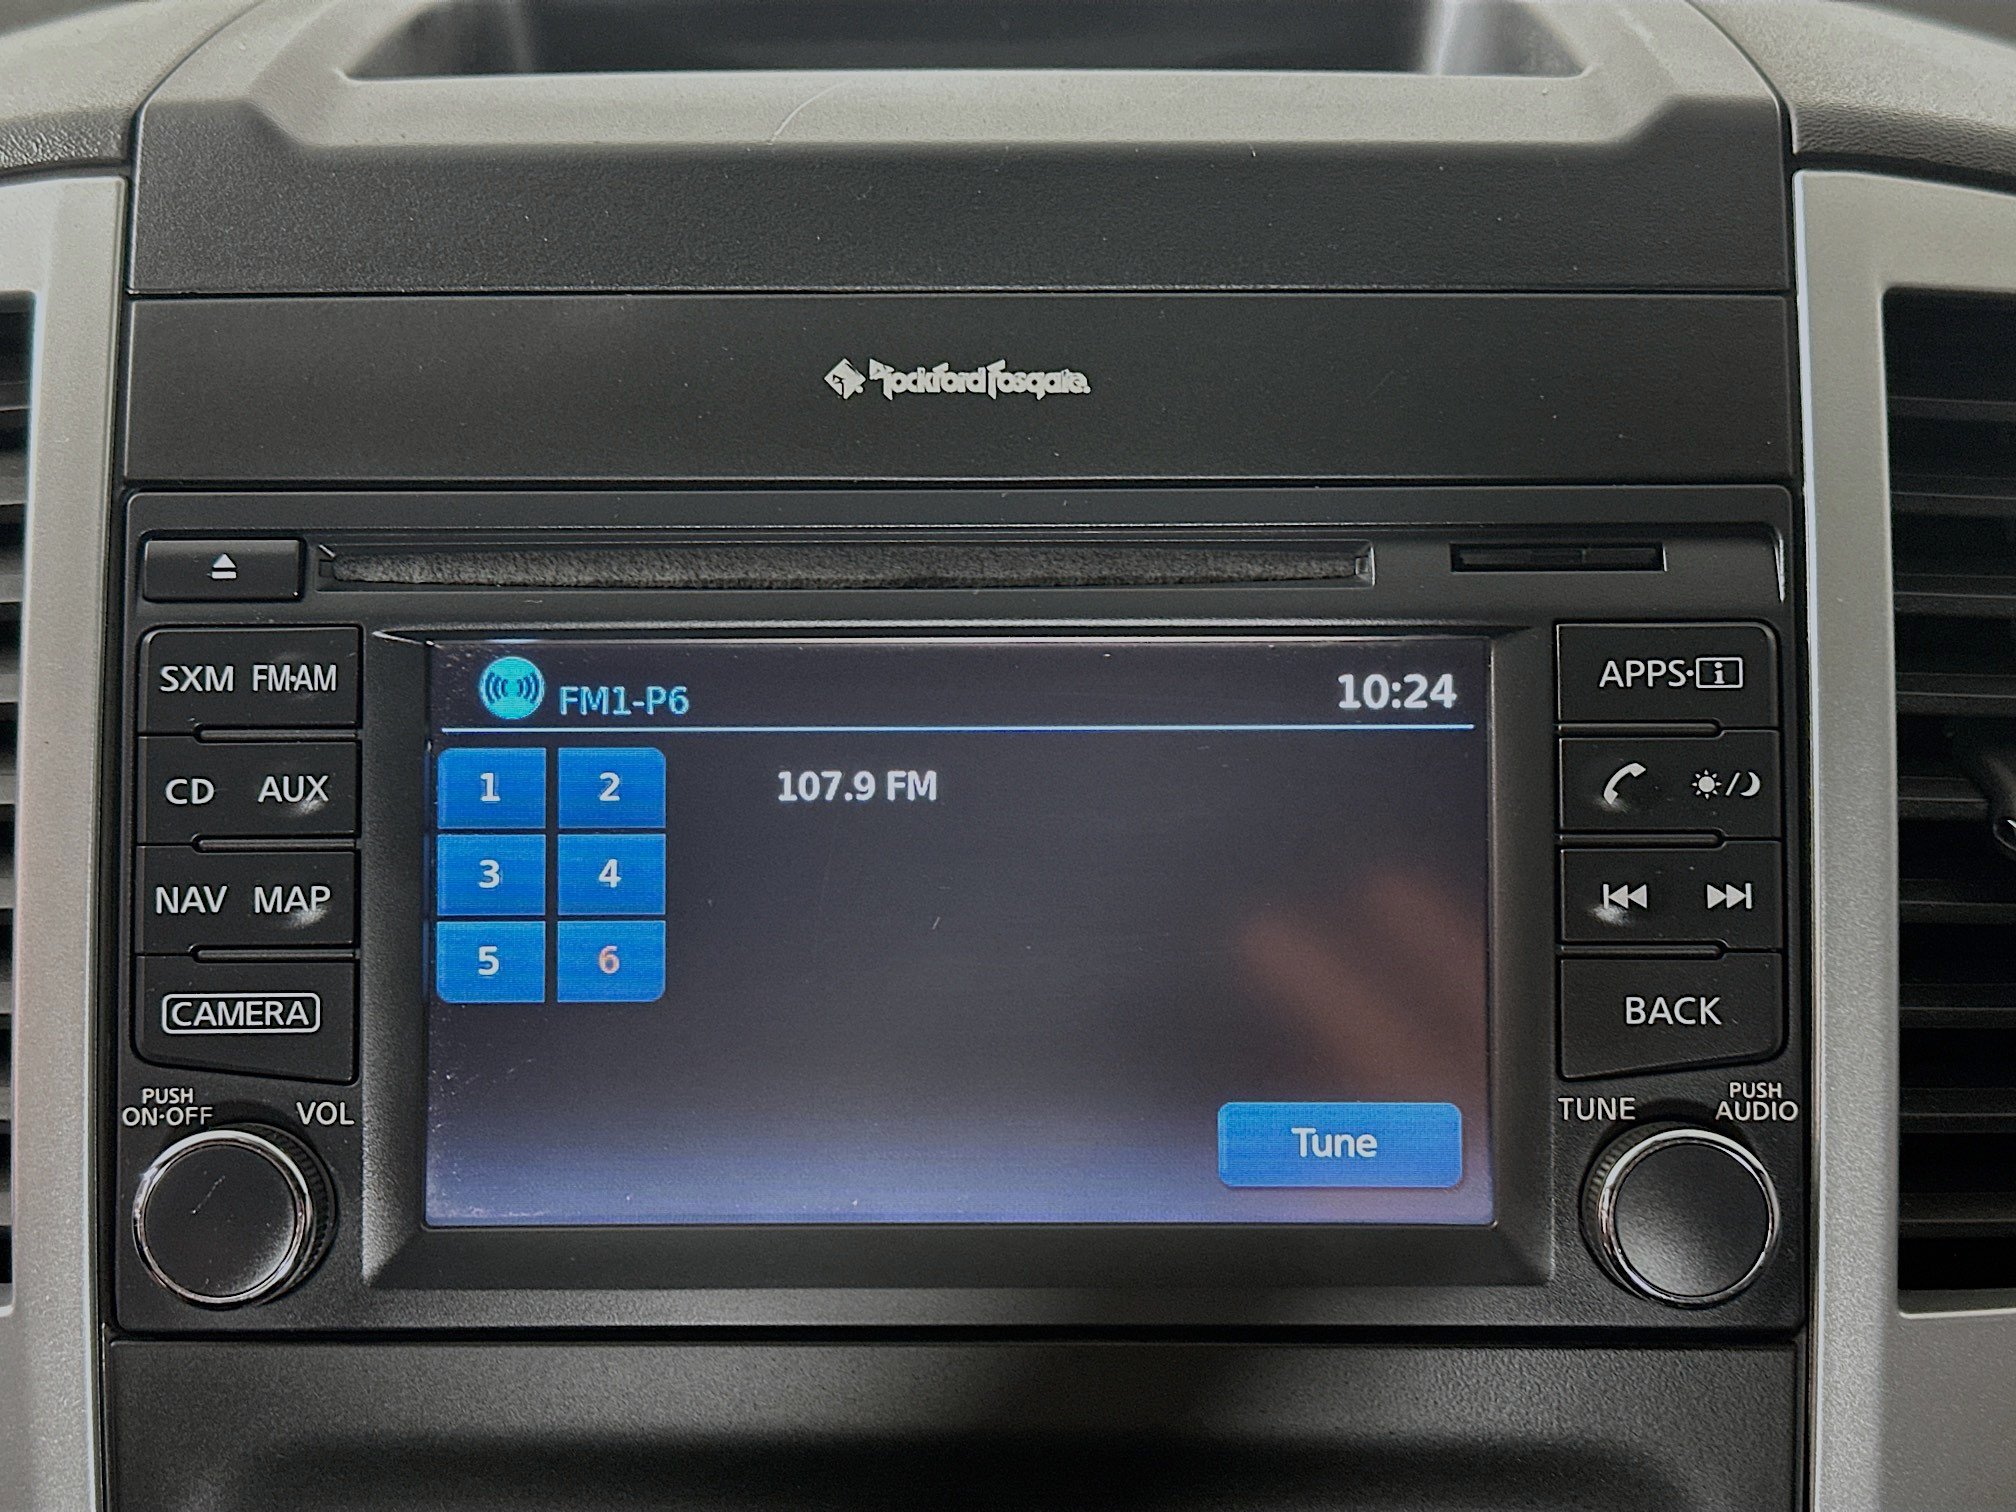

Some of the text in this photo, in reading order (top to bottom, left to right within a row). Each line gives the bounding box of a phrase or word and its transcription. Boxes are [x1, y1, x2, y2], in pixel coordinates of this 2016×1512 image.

[869, 358, 986, 400] Rockford
[159, 665, 234, 693] SXM
[1336, 672, 1458, 710] 10:24
[558, 685, 691, 716] FM1-P6
[164, 778, 216, 805] CD
[257, 775, 330, 803] AUX
[479, 771, 502, 802] 1
[598, 771, 621, 802] 2
[777, 769, 938, 802] 107.9 FM
[478, 858, 501, 889] 3
[598, 857, 622, 889] 4
[155, 886, 228, 914] NAV
[253, 886, 332, 914] MAP
[477, 945, 500, 977] 5
[598, 944, 621, 975] 6
[171, 1000, 310, 1027] CAMERA
[1624, 996, 1723, 1026] BACK
[141, 1087, 194, 1104] PUSH
[1728, 1082, 1783, 1099] PUSH
[295, 1101, 355, 1126] VOL
[1557, 1097, 1637, 1121] TUNE
[1714, 1101, 1799, 1122] AUDIO
[1290, 1126, 1378, 1159] Tune
